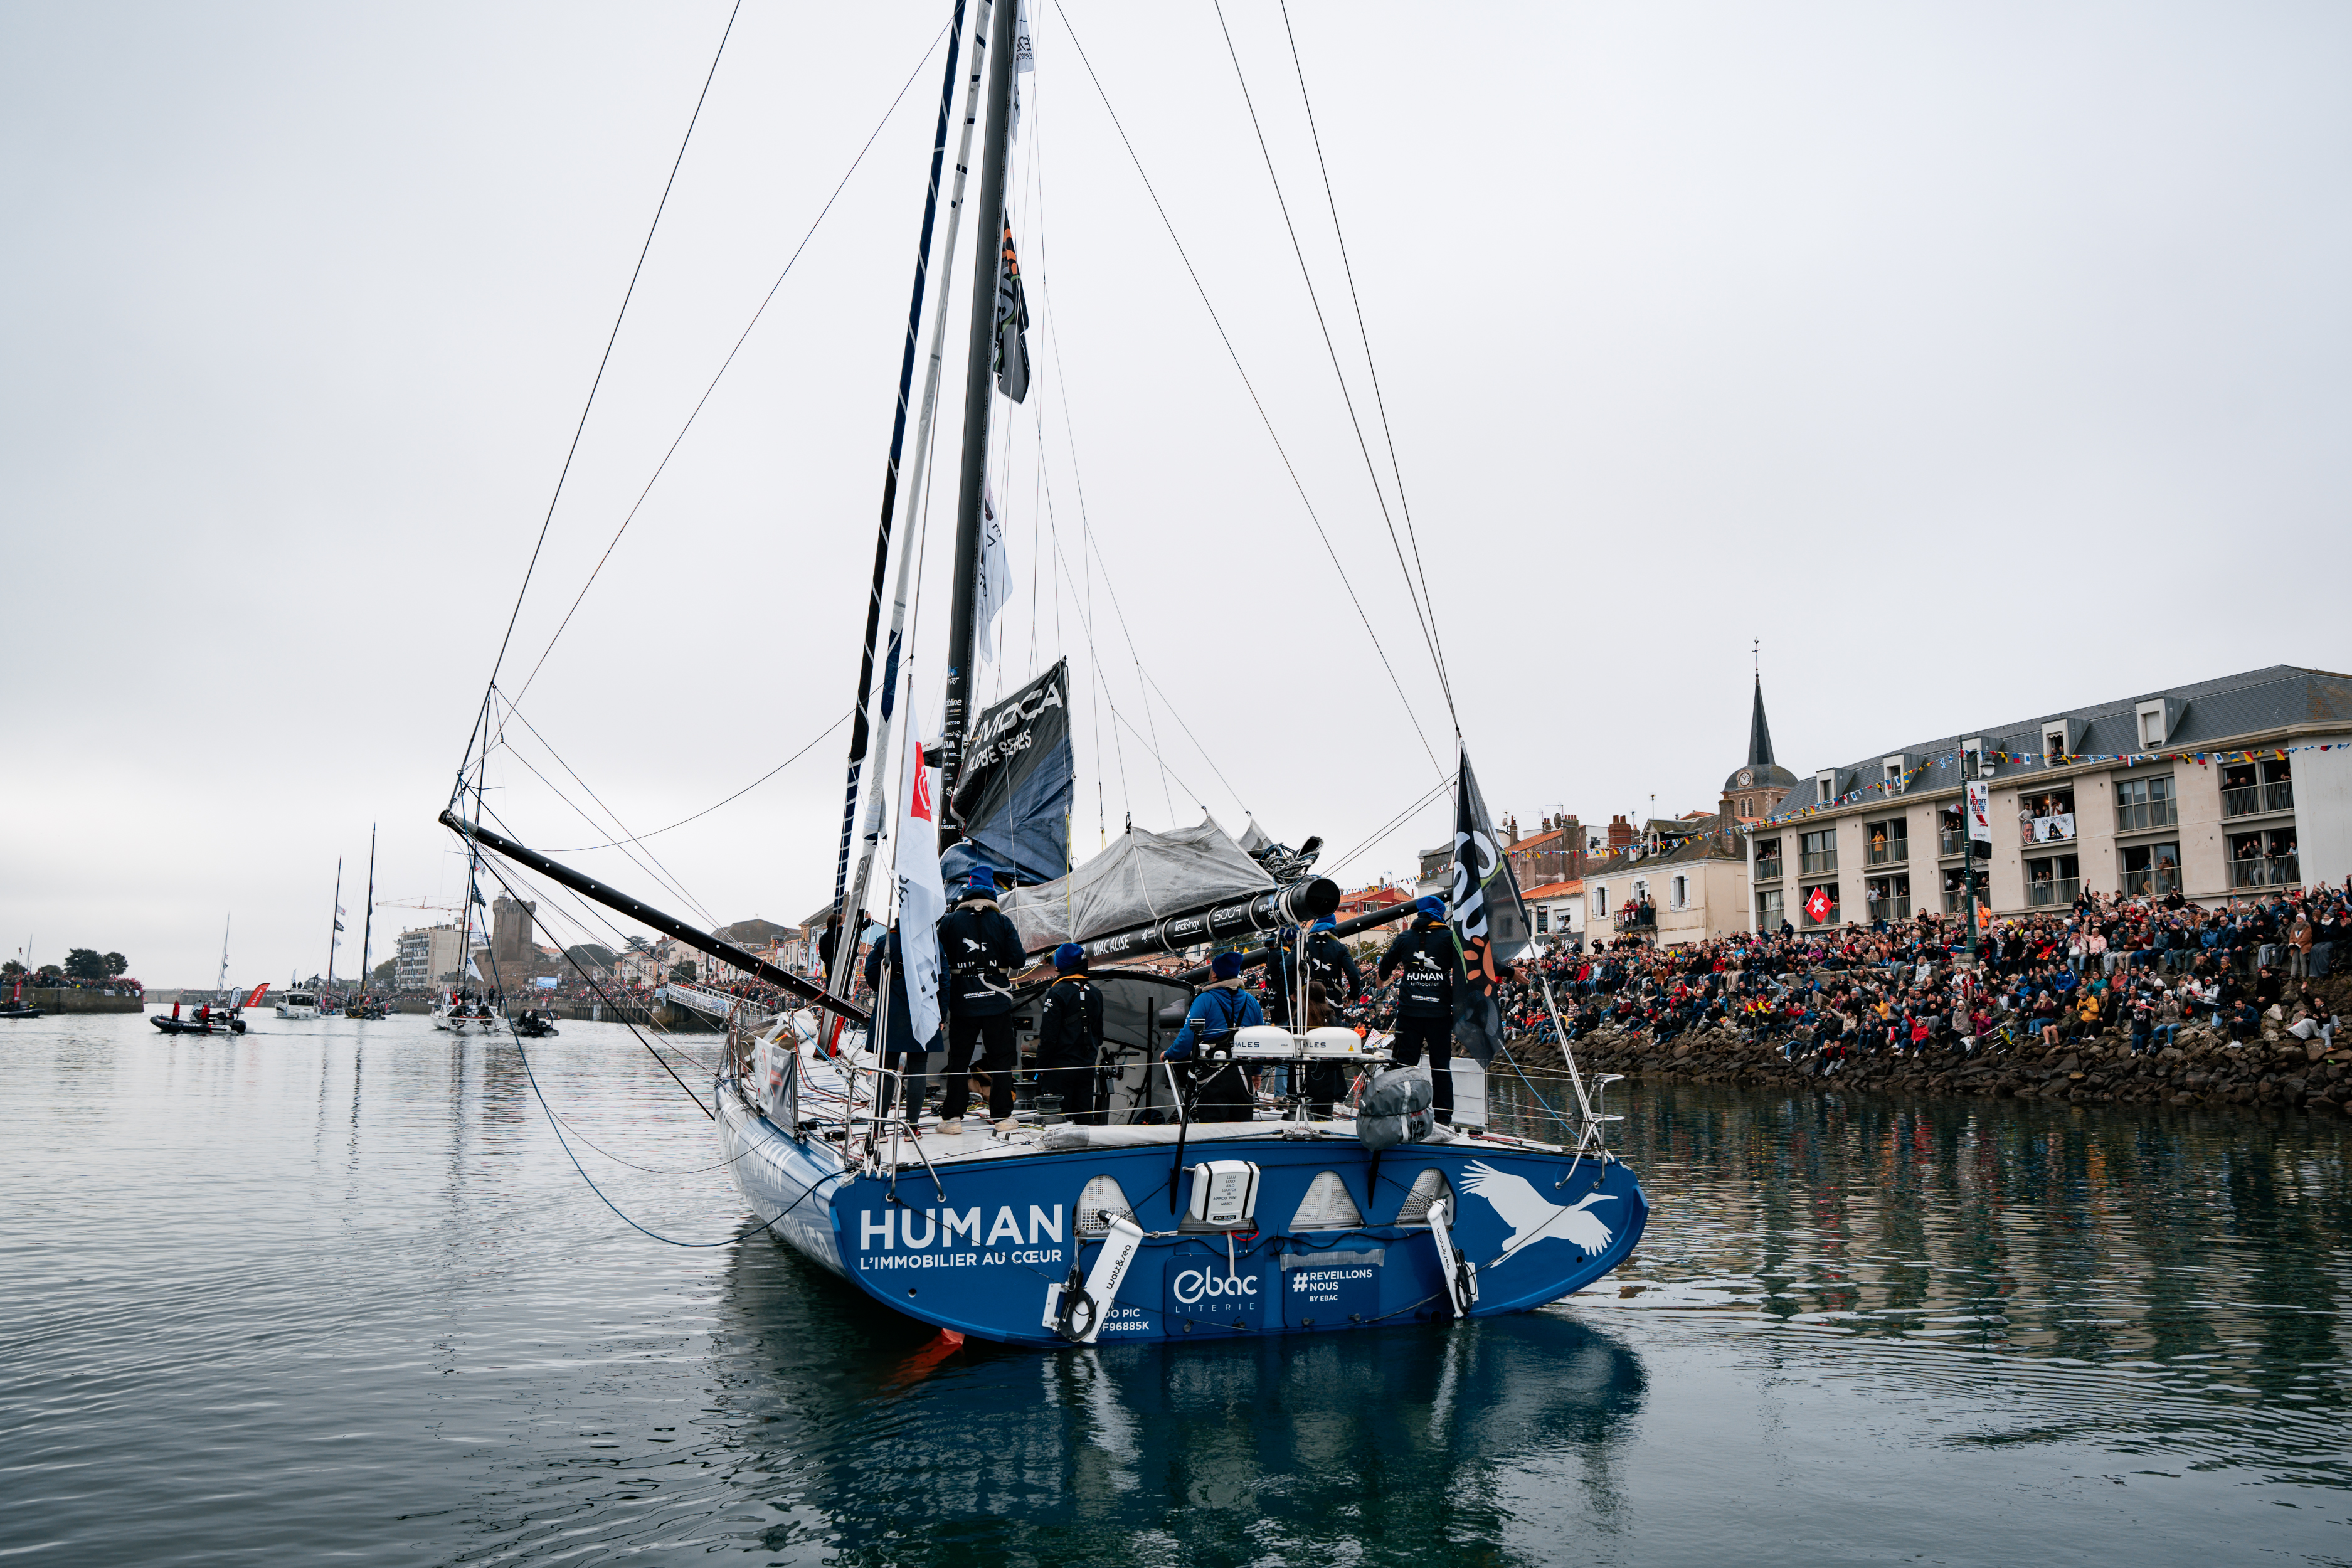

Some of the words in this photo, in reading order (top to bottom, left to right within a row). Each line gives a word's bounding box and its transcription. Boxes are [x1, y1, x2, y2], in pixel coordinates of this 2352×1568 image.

[975, 682, 1063, 748] IMOCA
[1259, 903, 1274, 913] HUMA
[1093, 939, 1110, 956] MAC
[1110, 933, 1130, 953] ALISE
[1407, 972, 1444, 981] HUMAN
[251, 989, 263, 1006] SAFETY
[860, 1204, 1062, 1250] HUMAN
[982, 1251, 1005, 1266] AU
[1010, 1249, 1062, 1264] CŒUR
[1106, 1244, 1131, 1290] watt&sea
[1173, 1265, 1258, 1304] ebac
[1310, 1281, 1338, 1292] NOUS
[1123, 1308, 1140, 1318] PIC
[1175, 1303, 1254, 1313] LITERIE
[1102, 1321, 1150, 1332] F96885K
